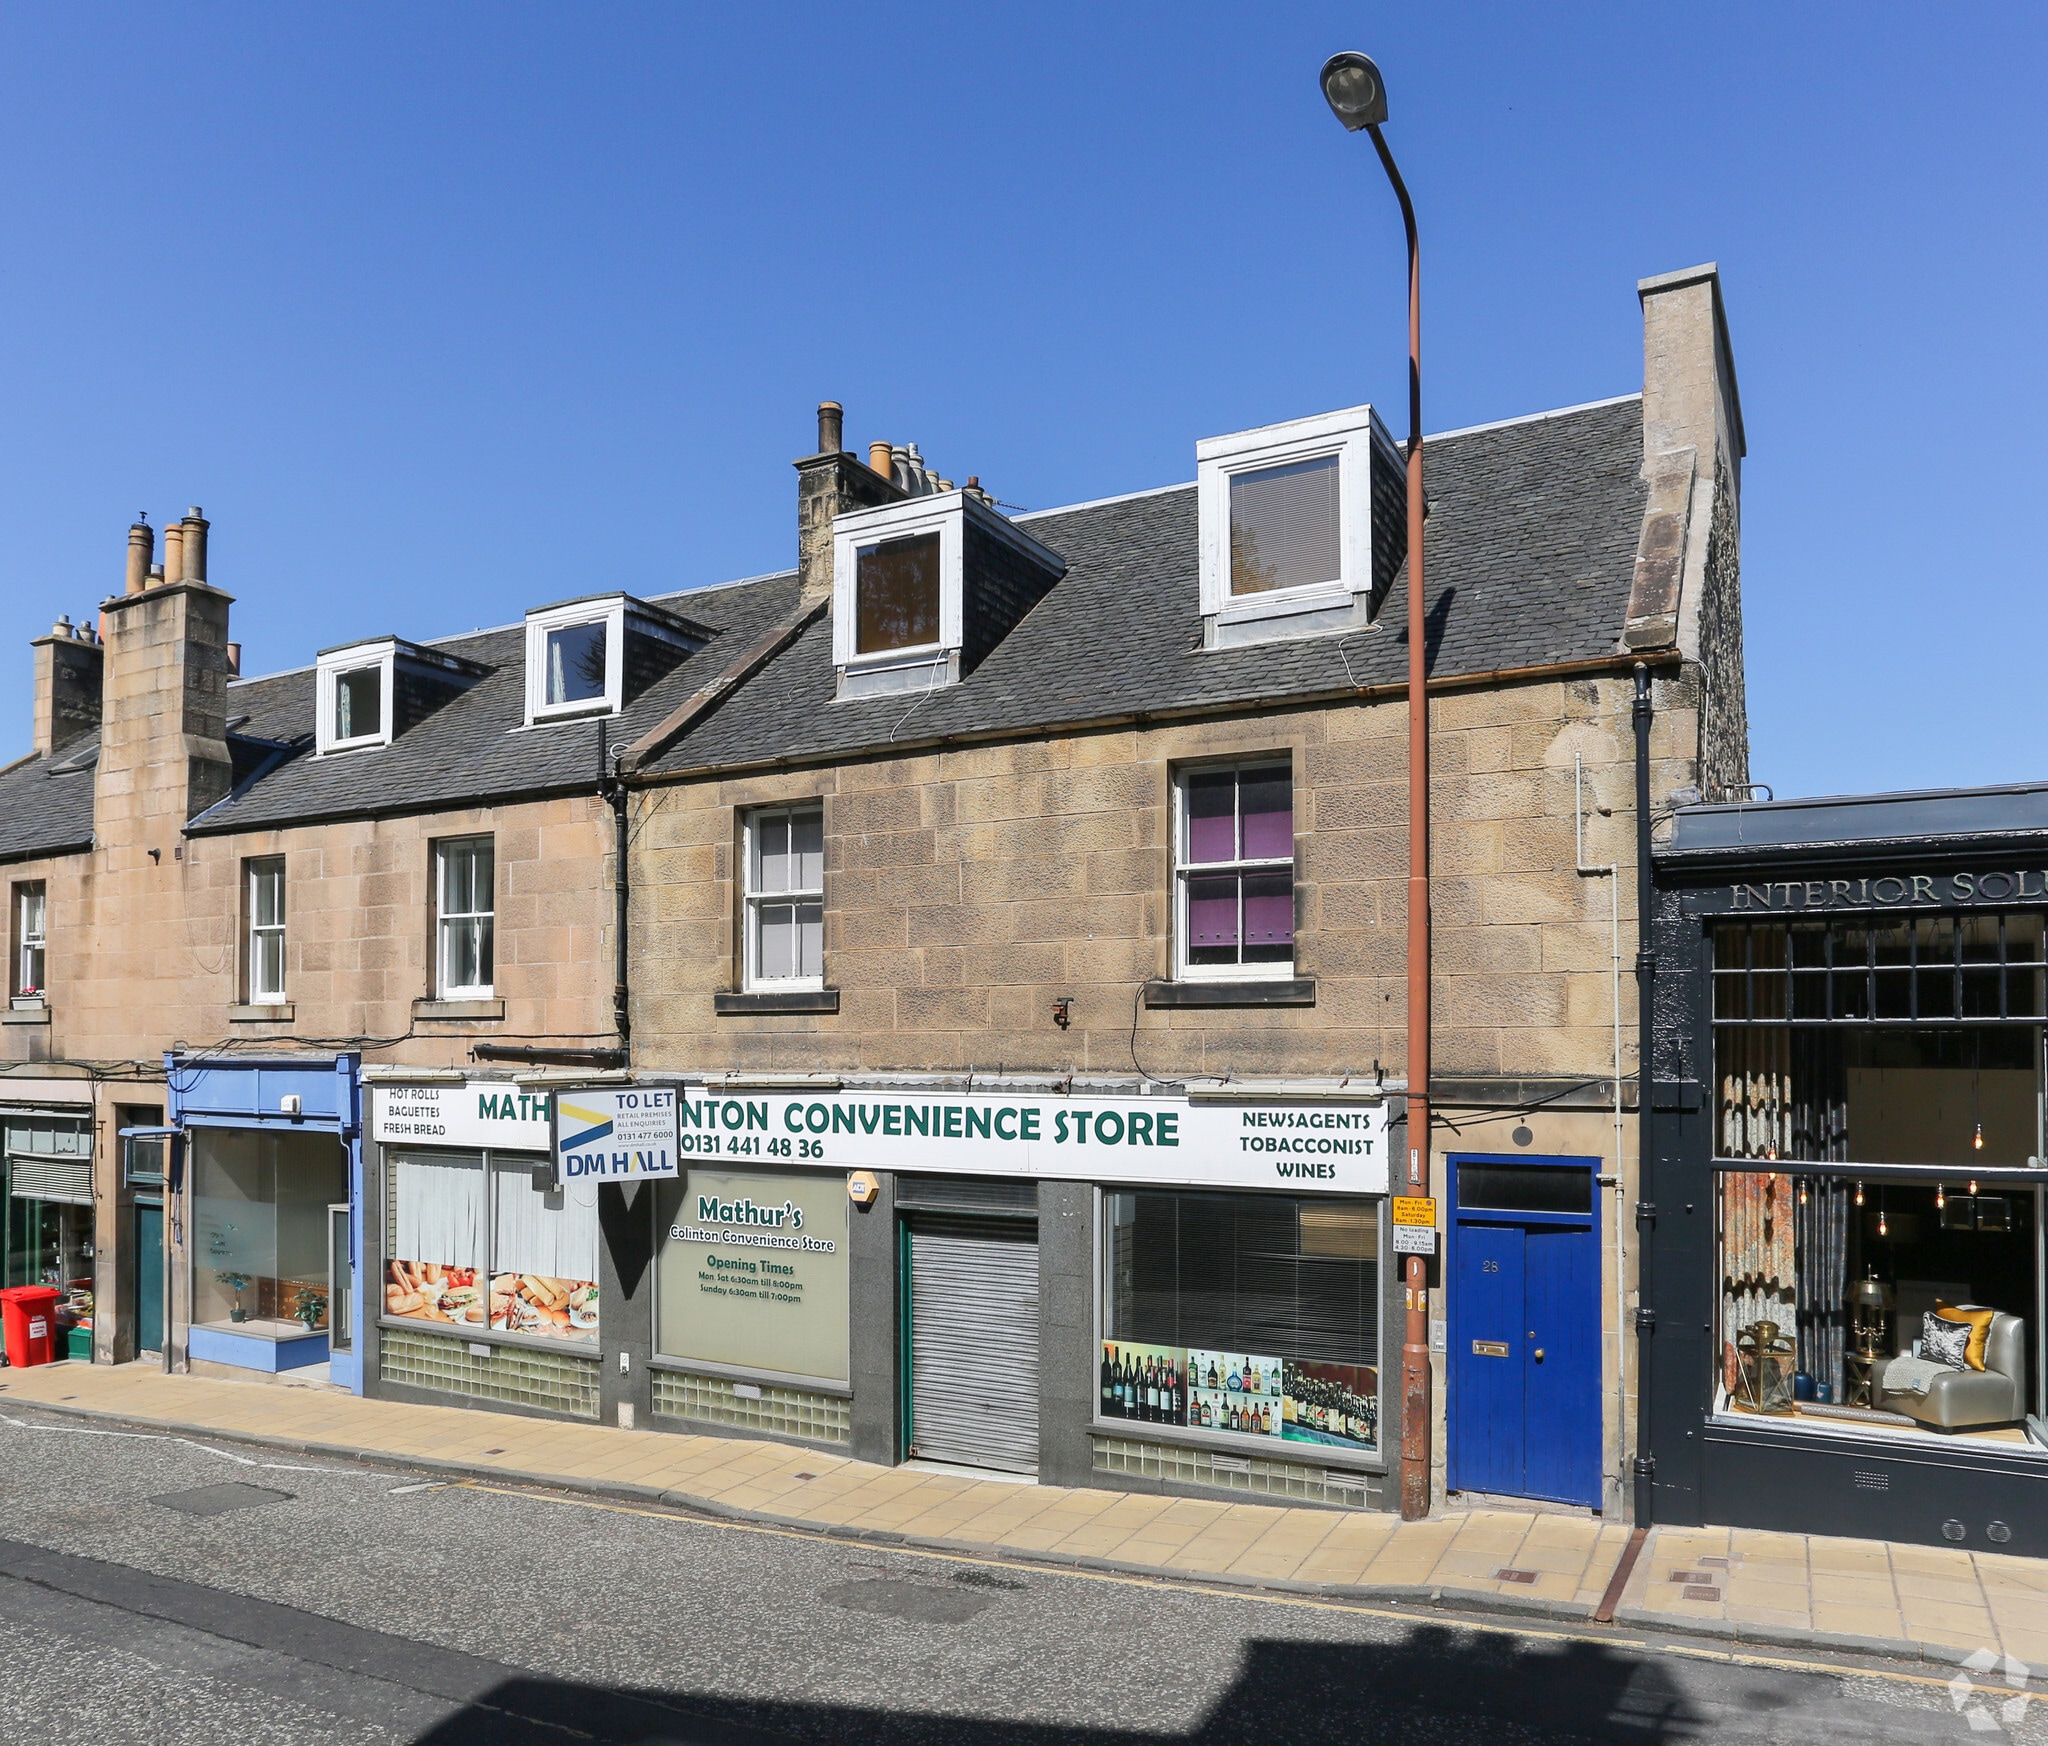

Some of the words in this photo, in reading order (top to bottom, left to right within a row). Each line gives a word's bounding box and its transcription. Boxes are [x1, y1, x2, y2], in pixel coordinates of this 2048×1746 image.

[1730, 875, 1941, 909] INTERIOR
[1951, 870, 2048, 900] SOL
[389, 1088, 409, 1100] HOT
[411, 1089, 439, 1100] ROLLS
[615, 1094, 639, 1109] TO
[644, 1093, 673, 1108] LET
[388, 1105, 440, 1118] BAGUETTES
[383, 1122, 411, 1134] FRESH
[414, 1123, 446, 1136] BREAD
[630, 1120, 666, 1128] ENQUIRIES
[784, 1102, 1041, 1141] CONVENIENCE
[1054, 1110, 1180, 1147] STORE
[1242, 1112, 1371, 1130] NEWSAGENTS
[653, 1131, 674, 1139] 6000
[681, 1134, 720, 1153] 0131
[727, 1136, 760, 1155] 441
[767, 1137, 792, 1157] 48
[798, 1139, 824, 1158] 36
[1240, 1136, 1374, 1155] TOBACCONIST
[566, 1153, 606, 1176] DM
[612, 1150, 674, 1174] HALL
[1276, 1162, 1336, 1179] WINES
[698, 1196, 803, 1229] Mathur's
[670, 1226, 719, 1242] Colinton
[722, 1229, 799, 1248] Convenience
[802, 1236, 834, 1251] Store
[707, 1254, 756, 1273] Opening
[760, 1260, 794, 1275] Times
[1483, 1260, 1499, 1273] 28
[698, 1271, 714, 1281] Mon
[717, 1273, 729, 1283] Sat
[730, 1275, 759, 1286] 6:30am
[760, 1278, 771, 1287] till
[700, 1284, 727, 1296] Sunday
[728, 1285, 757, 1297] 6:30am
[758, 1289, 769, 1299] till
[771, 1292, 801, 1303] 7:00pm
